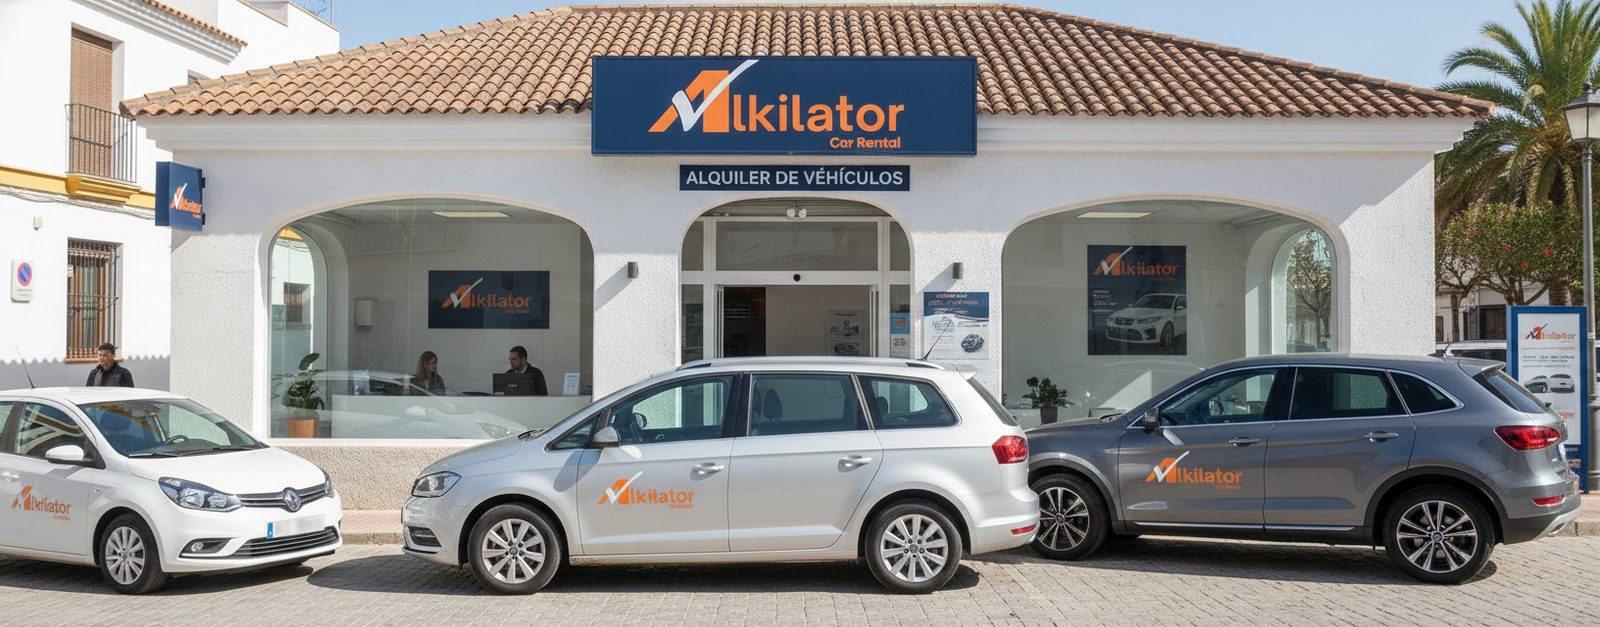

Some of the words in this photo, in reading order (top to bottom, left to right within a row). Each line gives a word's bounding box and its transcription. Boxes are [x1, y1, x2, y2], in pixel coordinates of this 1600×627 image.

[829, 136, 854, 149] Car
[857, 136, 901, 149] Rental
[686, 170, 770, 186] ALQUILER
[776, 170, 799, 185] DE
